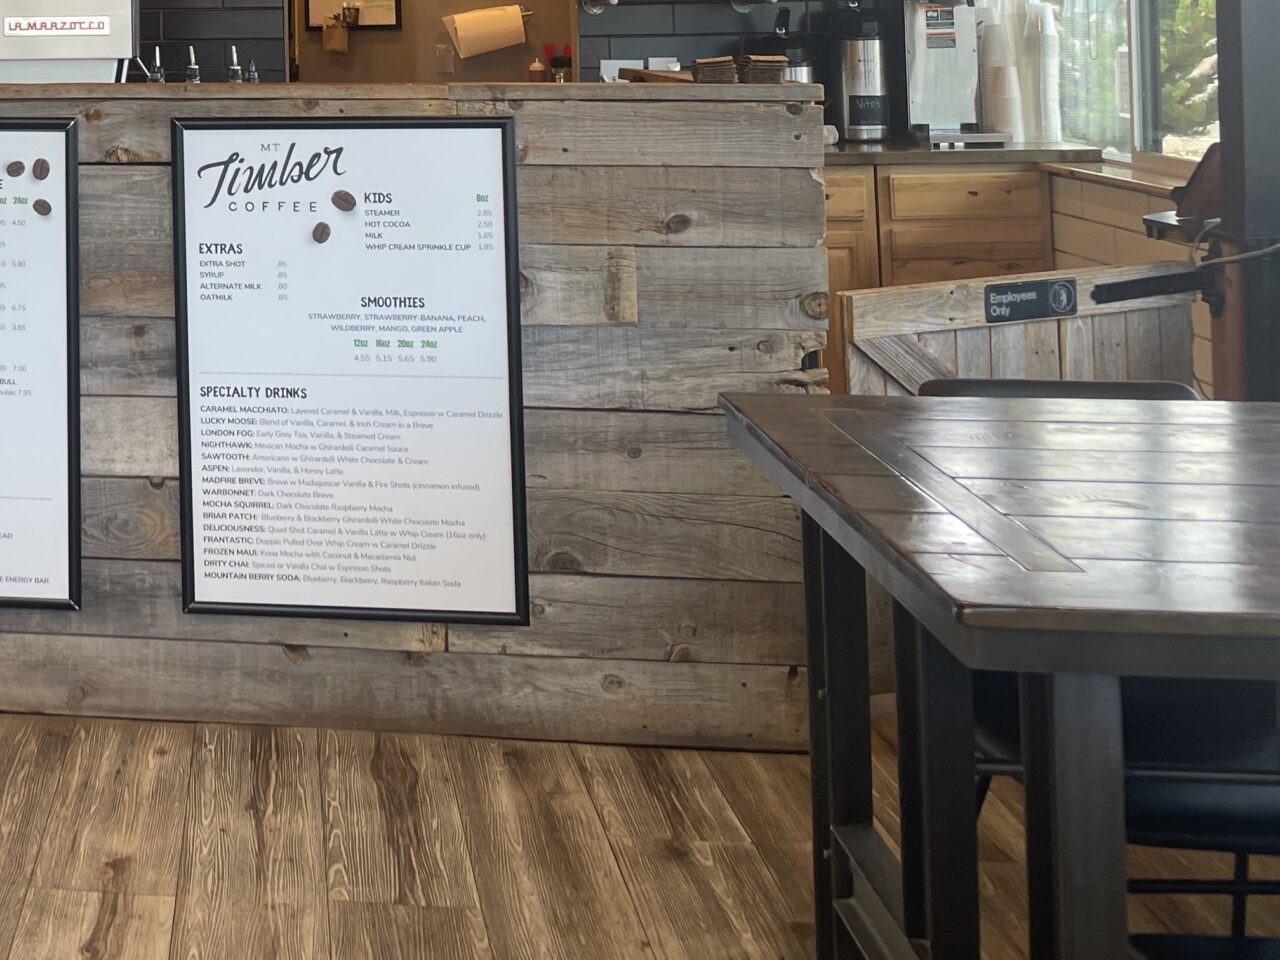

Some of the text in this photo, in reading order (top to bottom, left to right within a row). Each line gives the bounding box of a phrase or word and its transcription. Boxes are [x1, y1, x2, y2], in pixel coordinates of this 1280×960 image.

[260, 144, 280, 152] MT
[197, 142, 346, 208] Timber
[364, 192, 392, 204] KIDS
[228, 201, 318, 212] COFFEE
[365, 220, 410, 228] HOT COCOA
[199, 243, 242, 254] EXTRAS
[416, 243, 453, 251] SPRINKLE
[455, 243, 471, 251] CUP
[200, 282, 242, 290] ALTERNATE
[200, 293, 232, 301] OATMILK
[990, 292, 1037, 304] Employees
[361, 296, 425, 308] SMOOTHIES
[990, 306, 1010, 317] Only
[410, 325, 436, 333] GREEN
[438, 325, 462, 333] APPLE
[200, 386, 306, 398] SPECIALTY DRINKS
[200, 405, 288, 414] CARAMEL MACCHIATO:
[227, 417, 257, 425] MOOSE:
[200, 428, 254, 437] LONDON FOG:
[201, 440, 252, 448] NIGHTHAWK:
[201, 452, 250, 460] SAWTOOTH:
[201, 464, 229, 472] ASPEN:
[202, 476, 265, 485] MADFIRE BREVE:
[202, 488, 256, 496] WARBONNET:
[234, 500, 275, 509] SQUIRREL:
[202, 511, 257, 520] BRIAR PATCH:
[203, 524, 265, 532] DELICIOUSNESS:
[203, 547, 234, 555] FROZEN
[204, 559, 226, 567] DIRTY
[204, 571, 246, 579] MOUNTAIN
